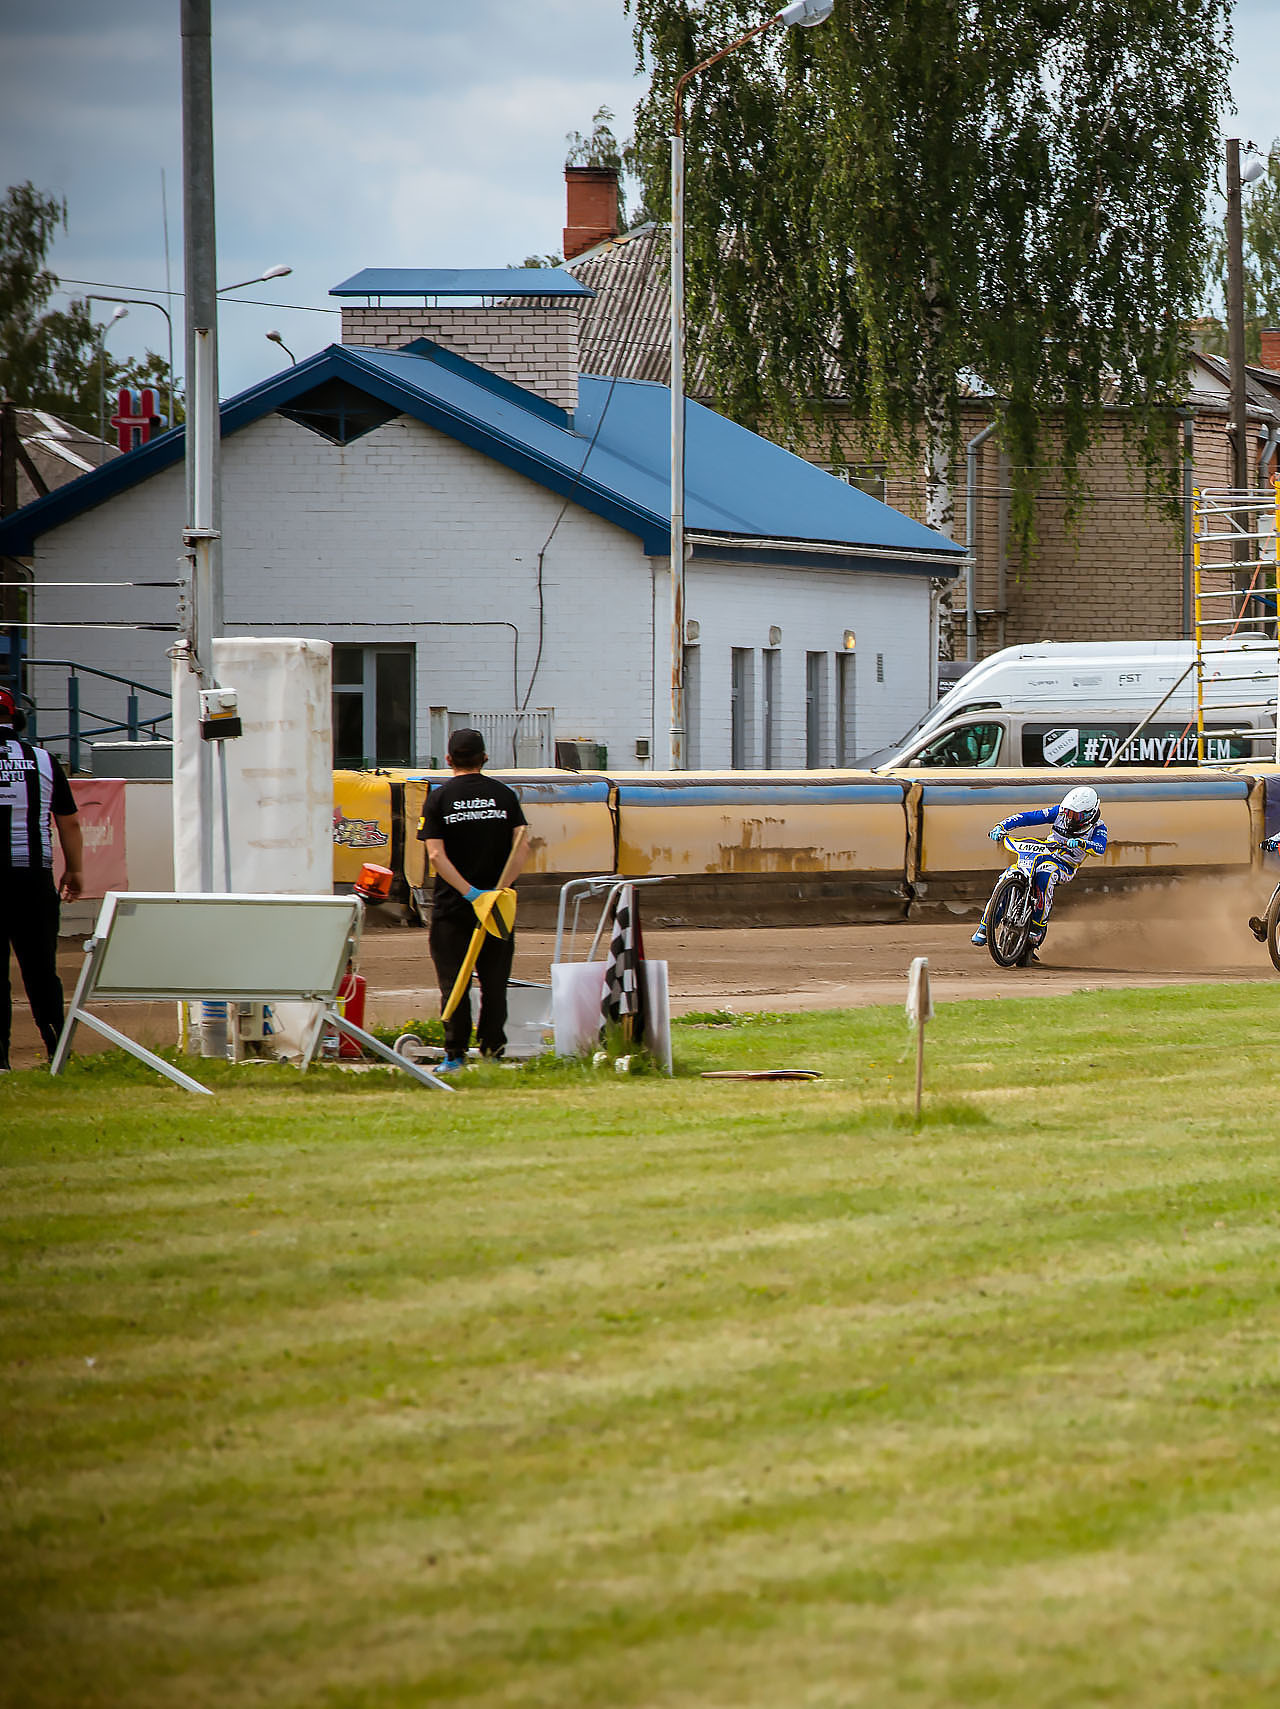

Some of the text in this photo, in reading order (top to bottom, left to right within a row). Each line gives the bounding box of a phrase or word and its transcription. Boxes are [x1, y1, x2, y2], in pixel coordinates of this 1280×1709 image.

[1119, 673, 1142, 683] FST
[1083, 734, 1231, 762] #ŻYJEMYŻUŻEM
[453, 798, 496, 810] SŁUŻBA
[443, 809, 508, 824] TECHNICZNA
[1018, 843, 1046, 853] LAVOR
